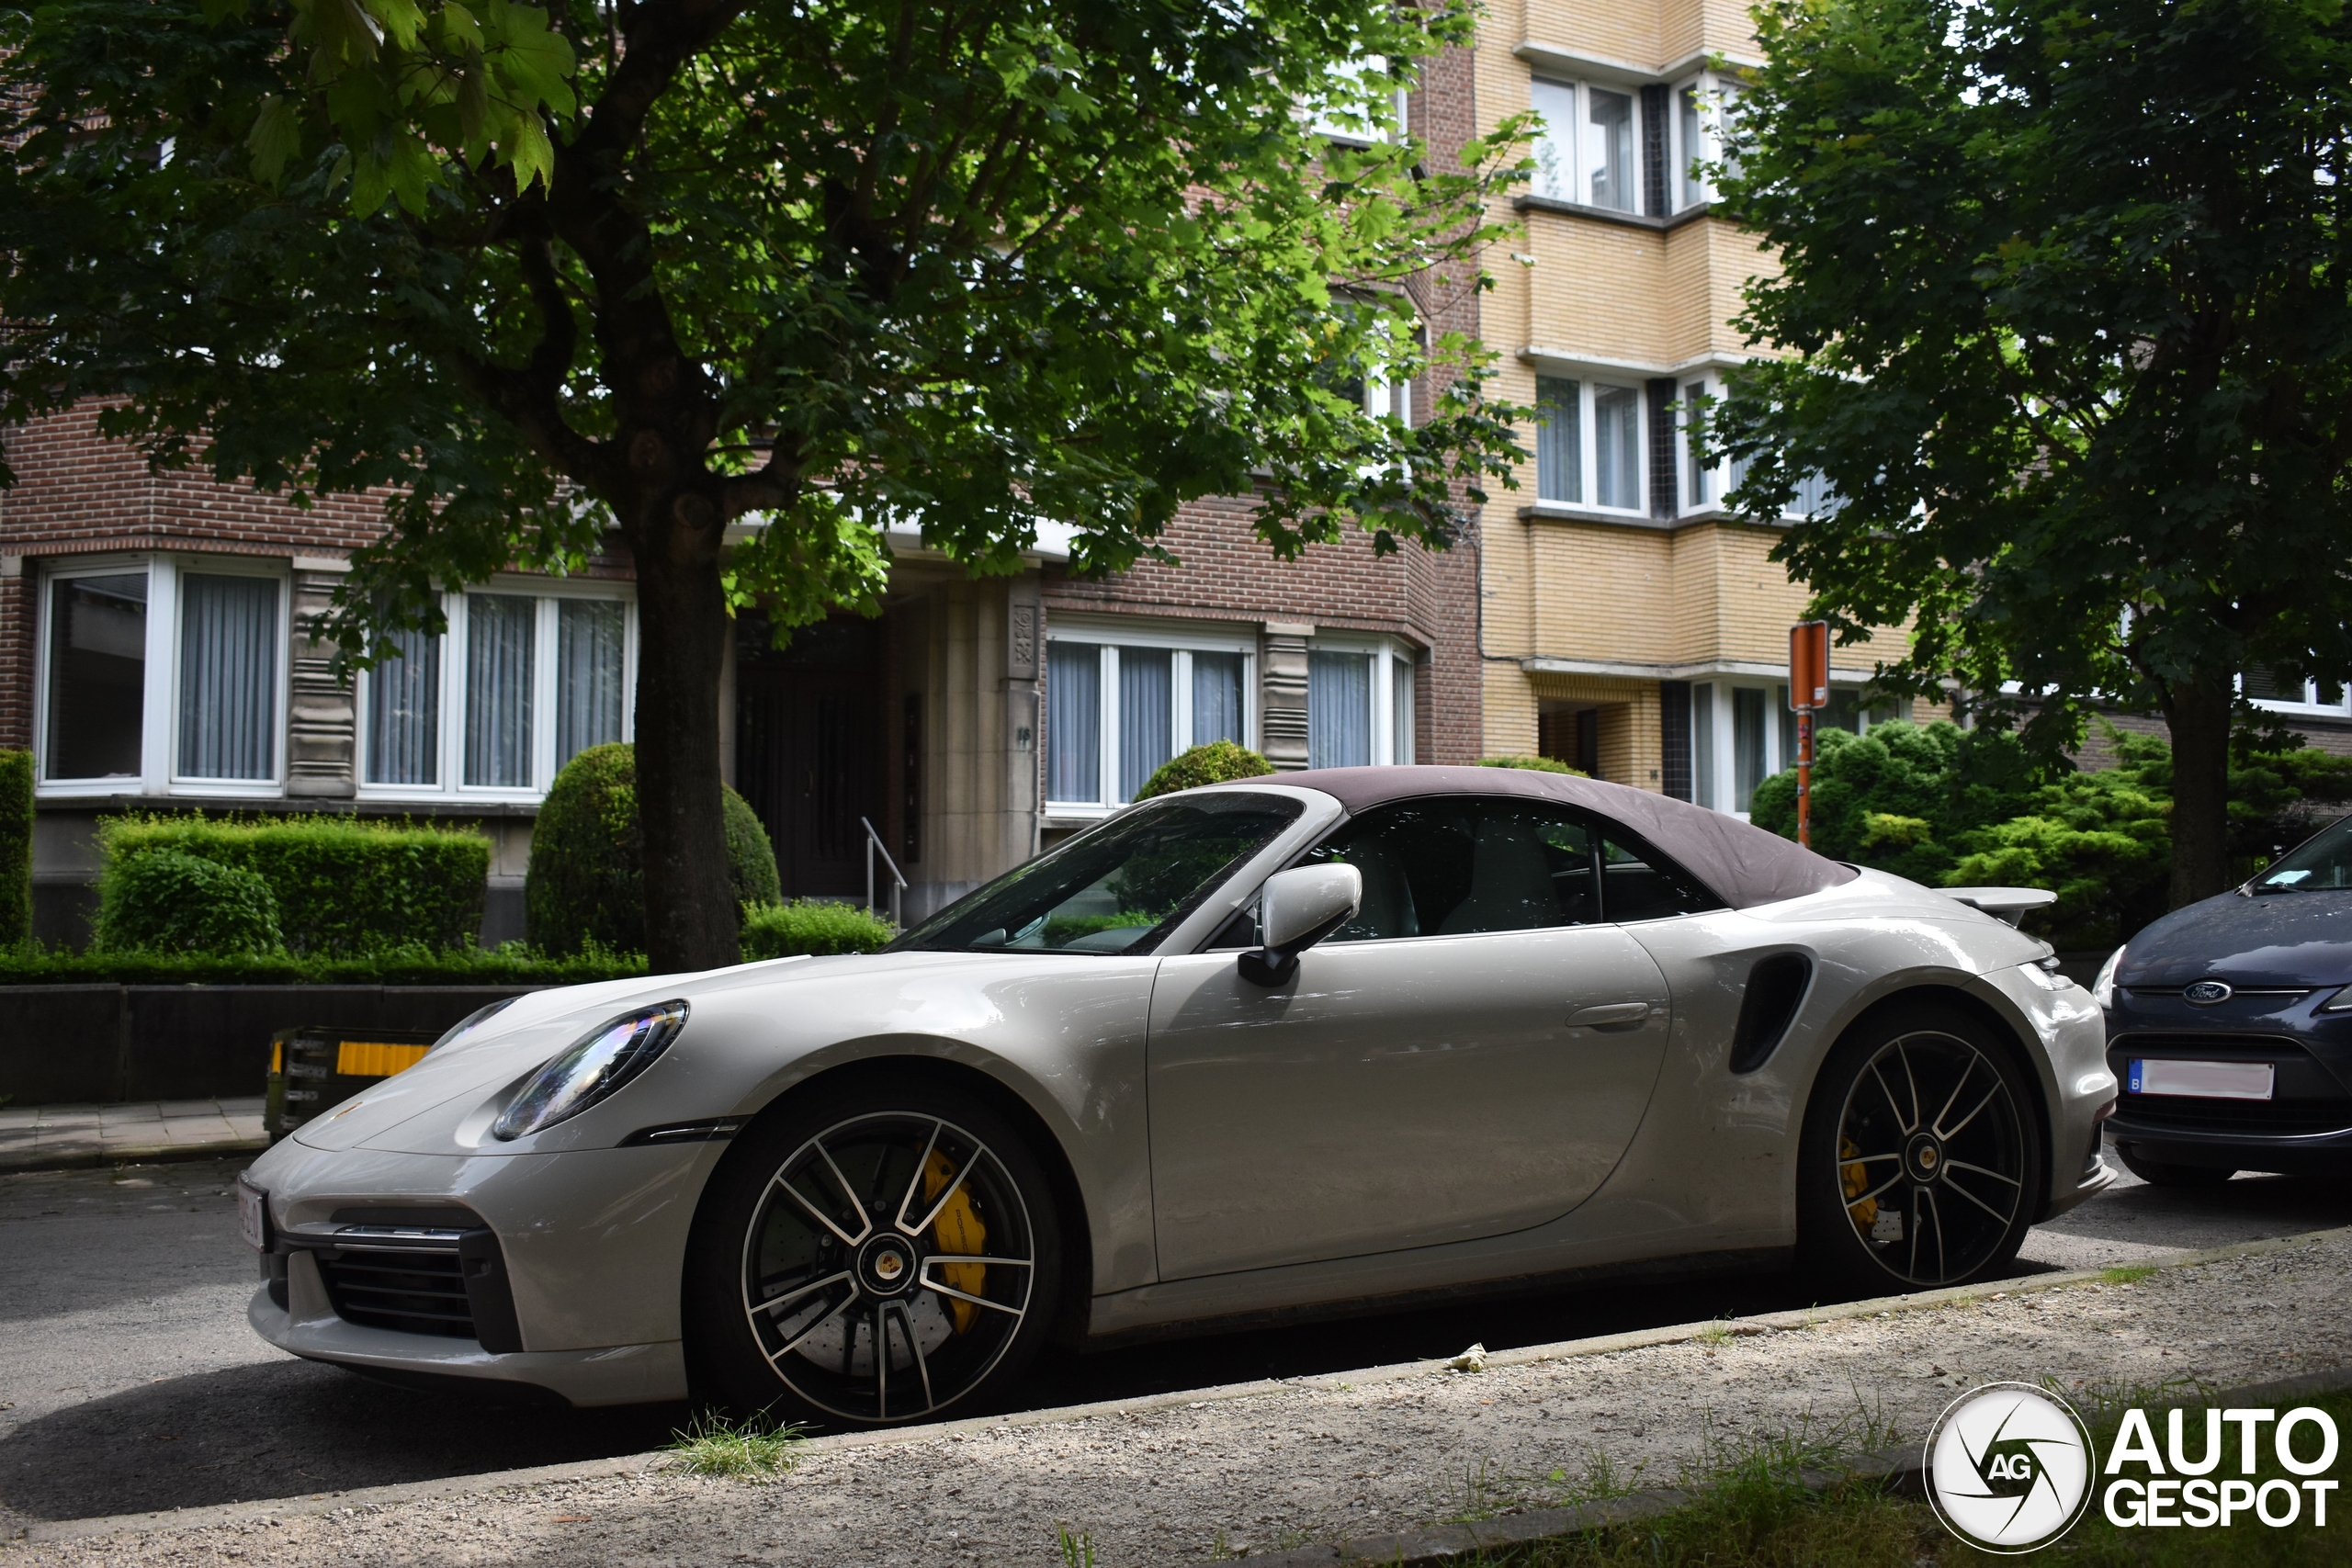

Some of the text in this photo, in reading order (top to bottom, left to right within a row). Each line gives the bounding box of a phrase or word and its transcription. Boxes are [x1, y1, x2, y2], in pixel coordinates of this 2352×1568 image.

[2191, 984, 2220, 998] Ford
[2132, 1078, 2140, 1090] B
[955, 1208, 972, 1269] PORSCE
